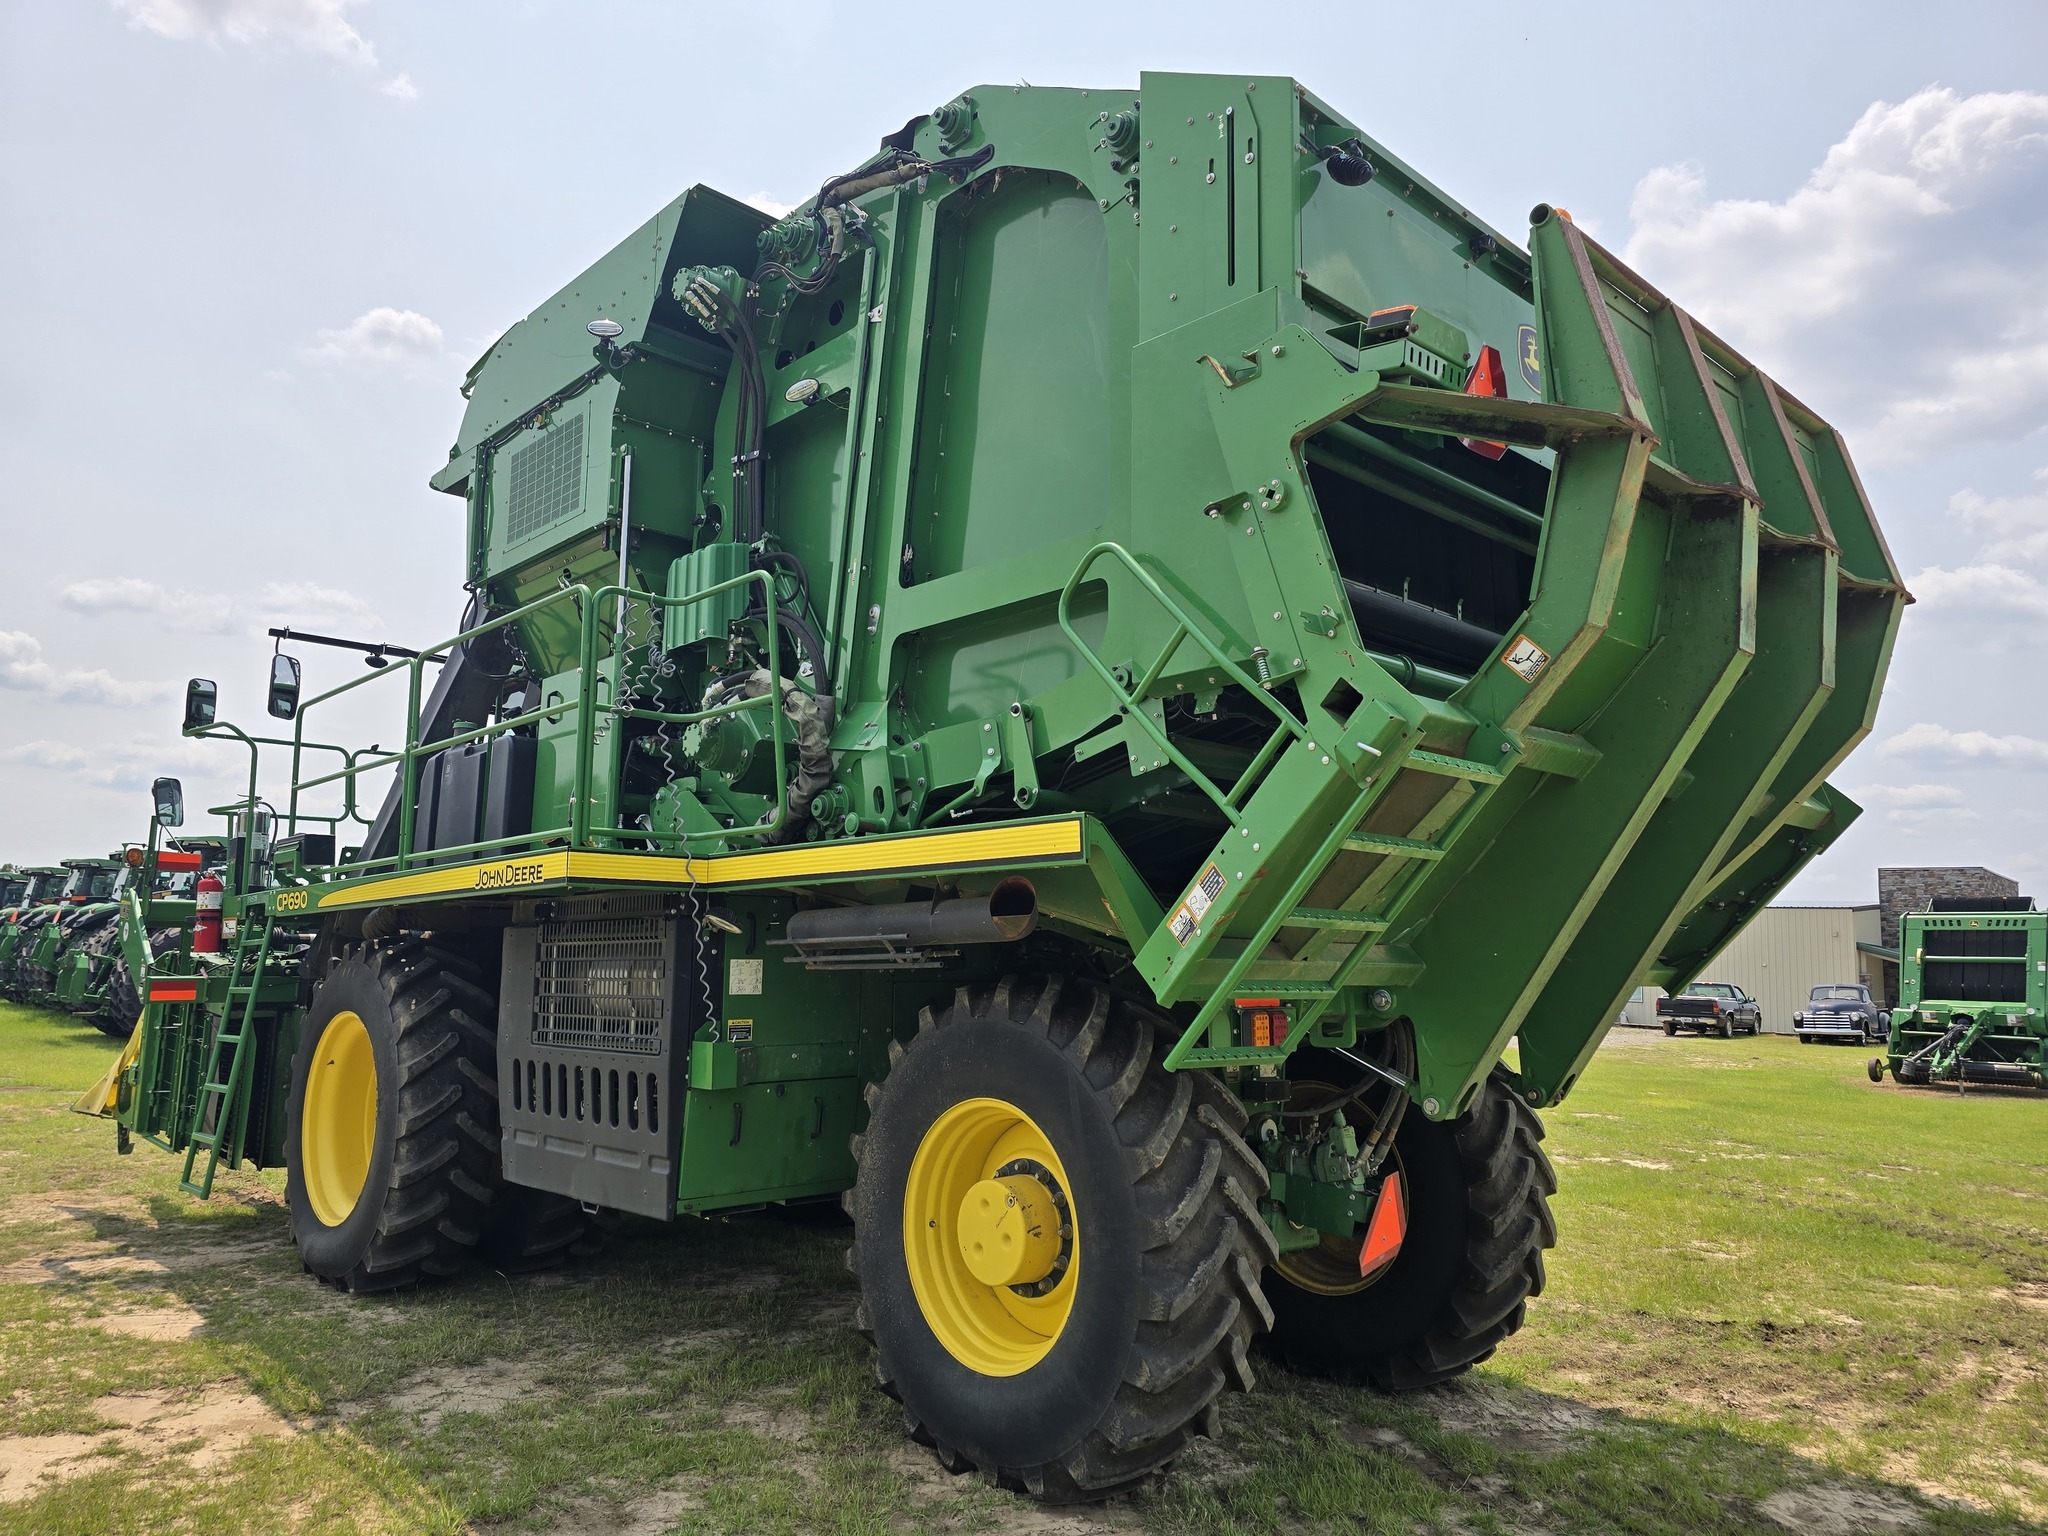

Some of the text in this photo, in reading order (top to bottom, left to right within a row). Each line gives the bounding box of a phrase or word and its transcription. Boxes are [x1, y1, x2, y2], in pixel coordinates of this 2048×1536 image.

[1506, 636, 1524, 657] WARNING
[475, 864, 544, 887] JOHN DEERE
[276, 890, 308, 912] CP690
